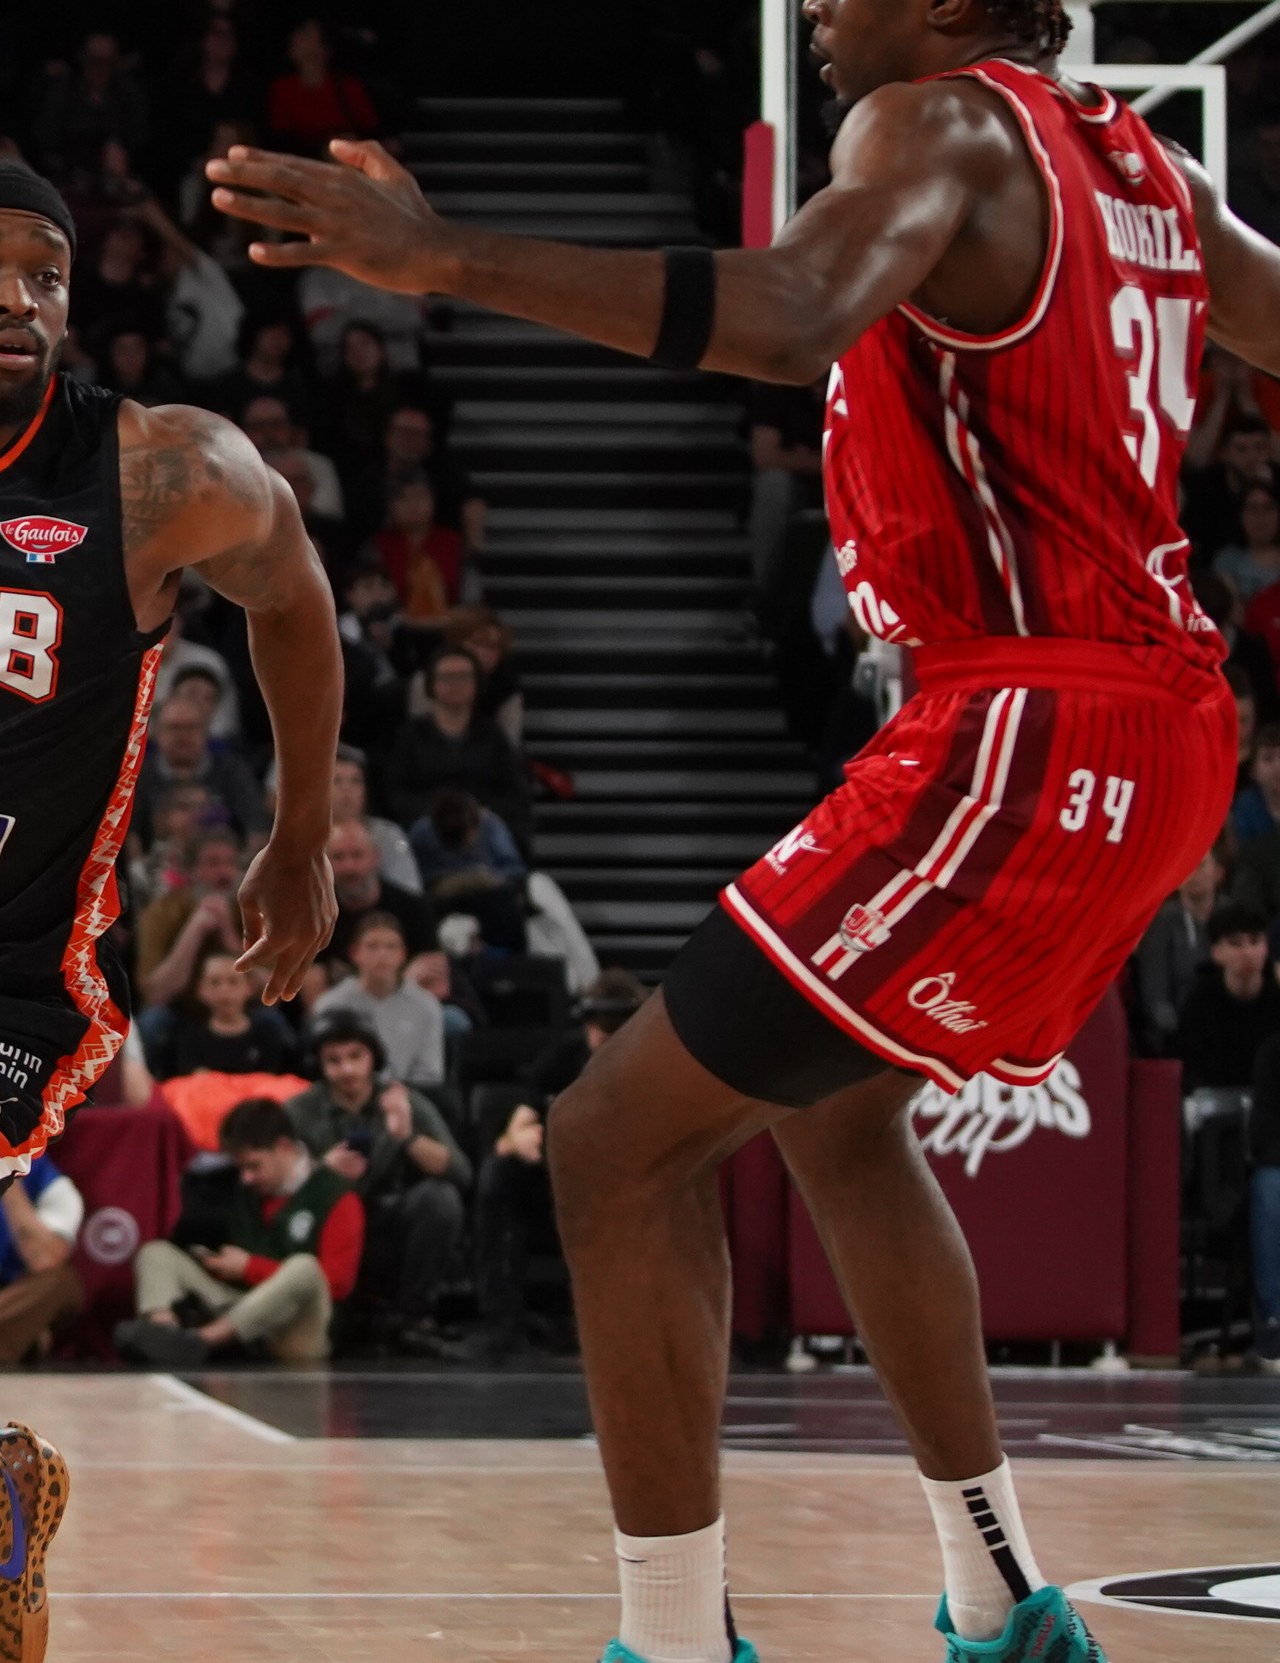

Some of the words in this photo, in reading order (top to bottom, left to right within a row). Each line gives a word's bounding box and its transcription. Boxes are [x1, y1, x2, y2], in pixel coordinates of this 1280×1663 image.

[1094, 188, 1201, 271] KOKIL
[14, 521, 79, 545] Gaulois
[1059, 768, 1135, 844] 34
